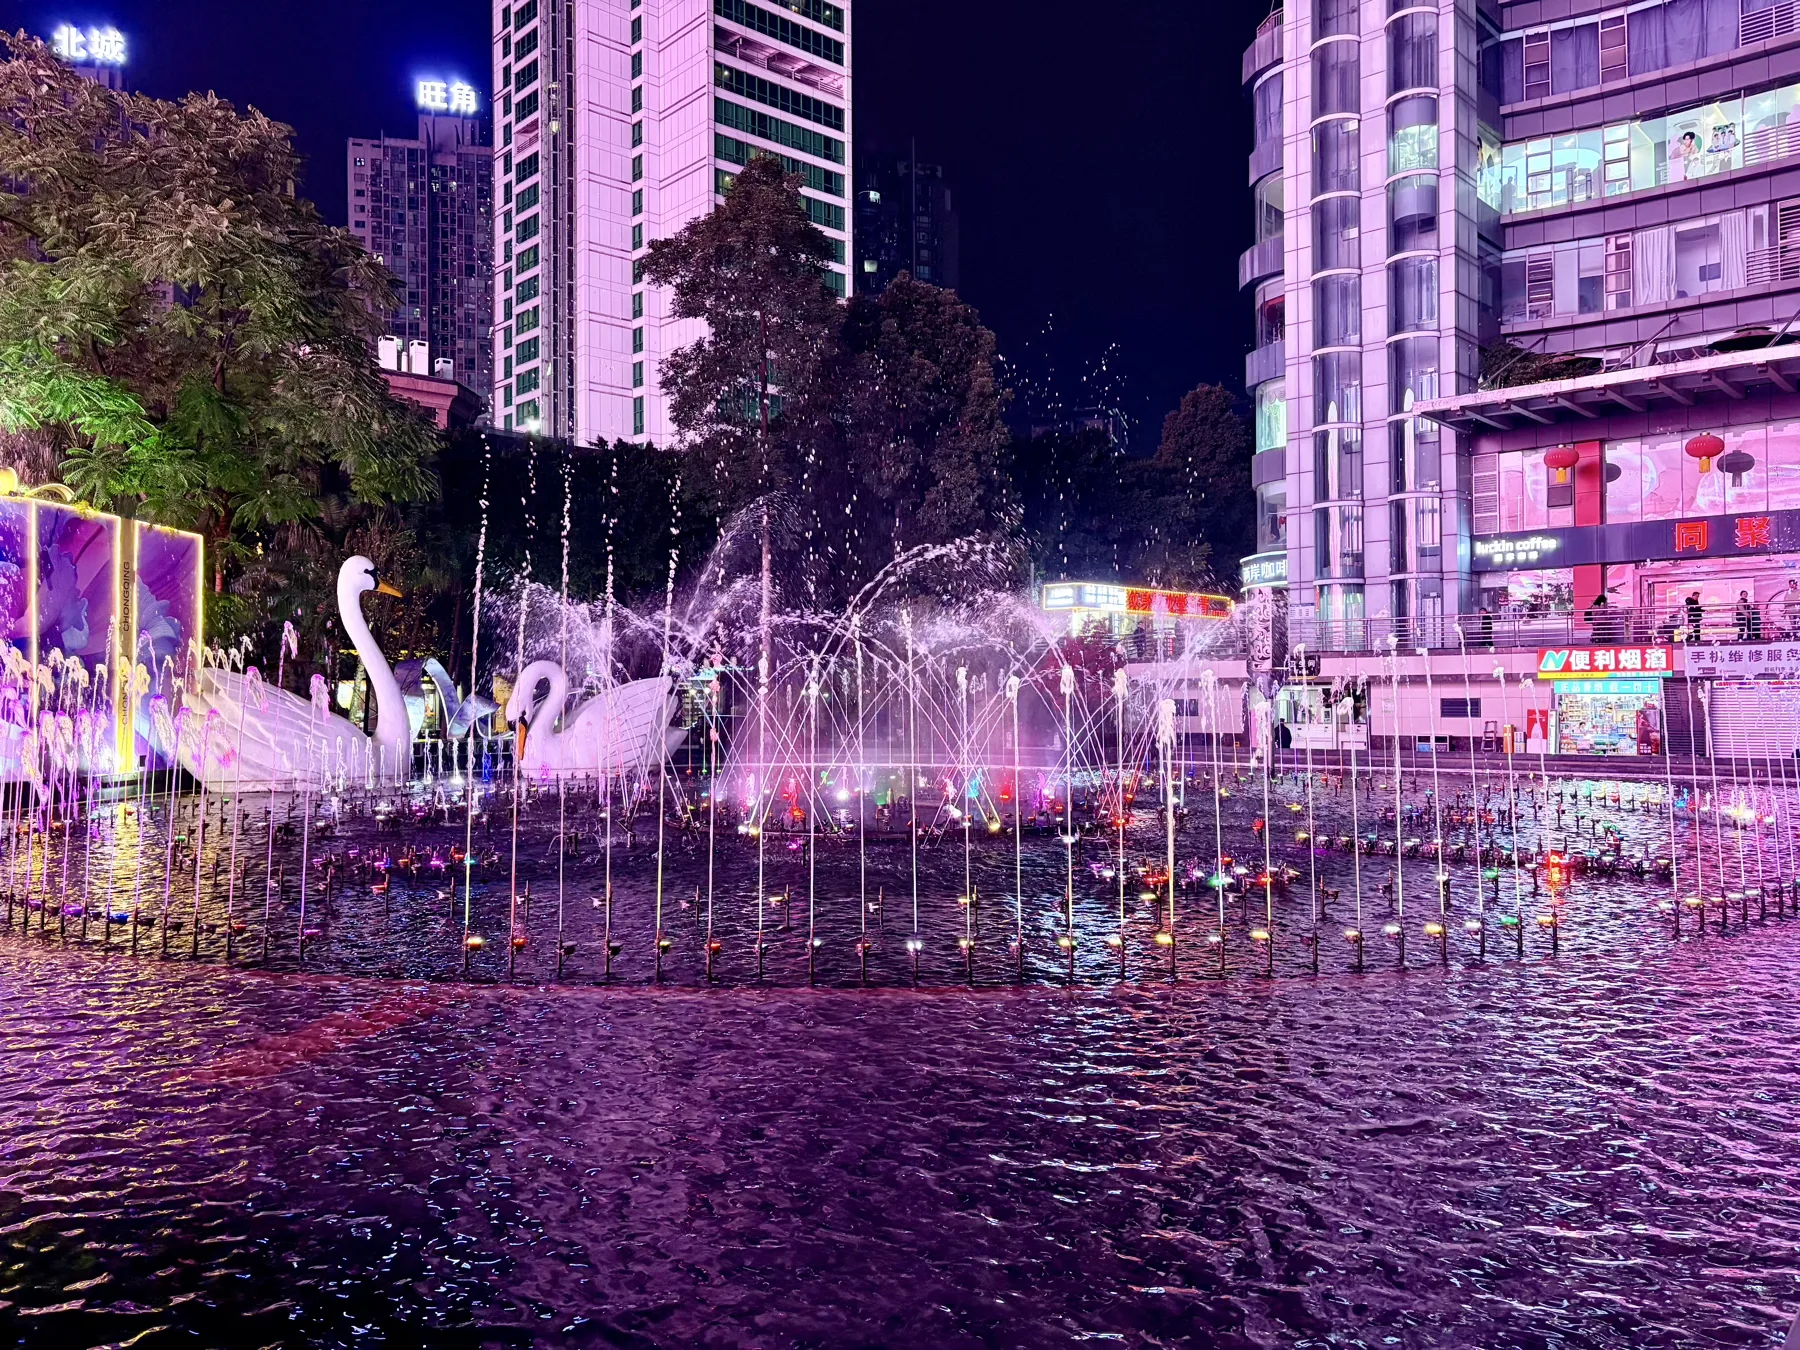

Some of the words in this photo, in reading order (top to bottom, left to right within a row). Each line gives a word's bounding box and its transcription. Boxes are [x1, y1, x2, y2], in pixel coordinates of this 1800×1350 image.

[53, 25, 126, 63] 北城
[418, 81, 477, 114] 旺角
[1475, 540, 1514, 554] luckin
[1516, 536, 1557, 550] coffee
[123, 561, 131, 632] CHONGQING
[1569, 648, 1667, 670] 便利烟酒
